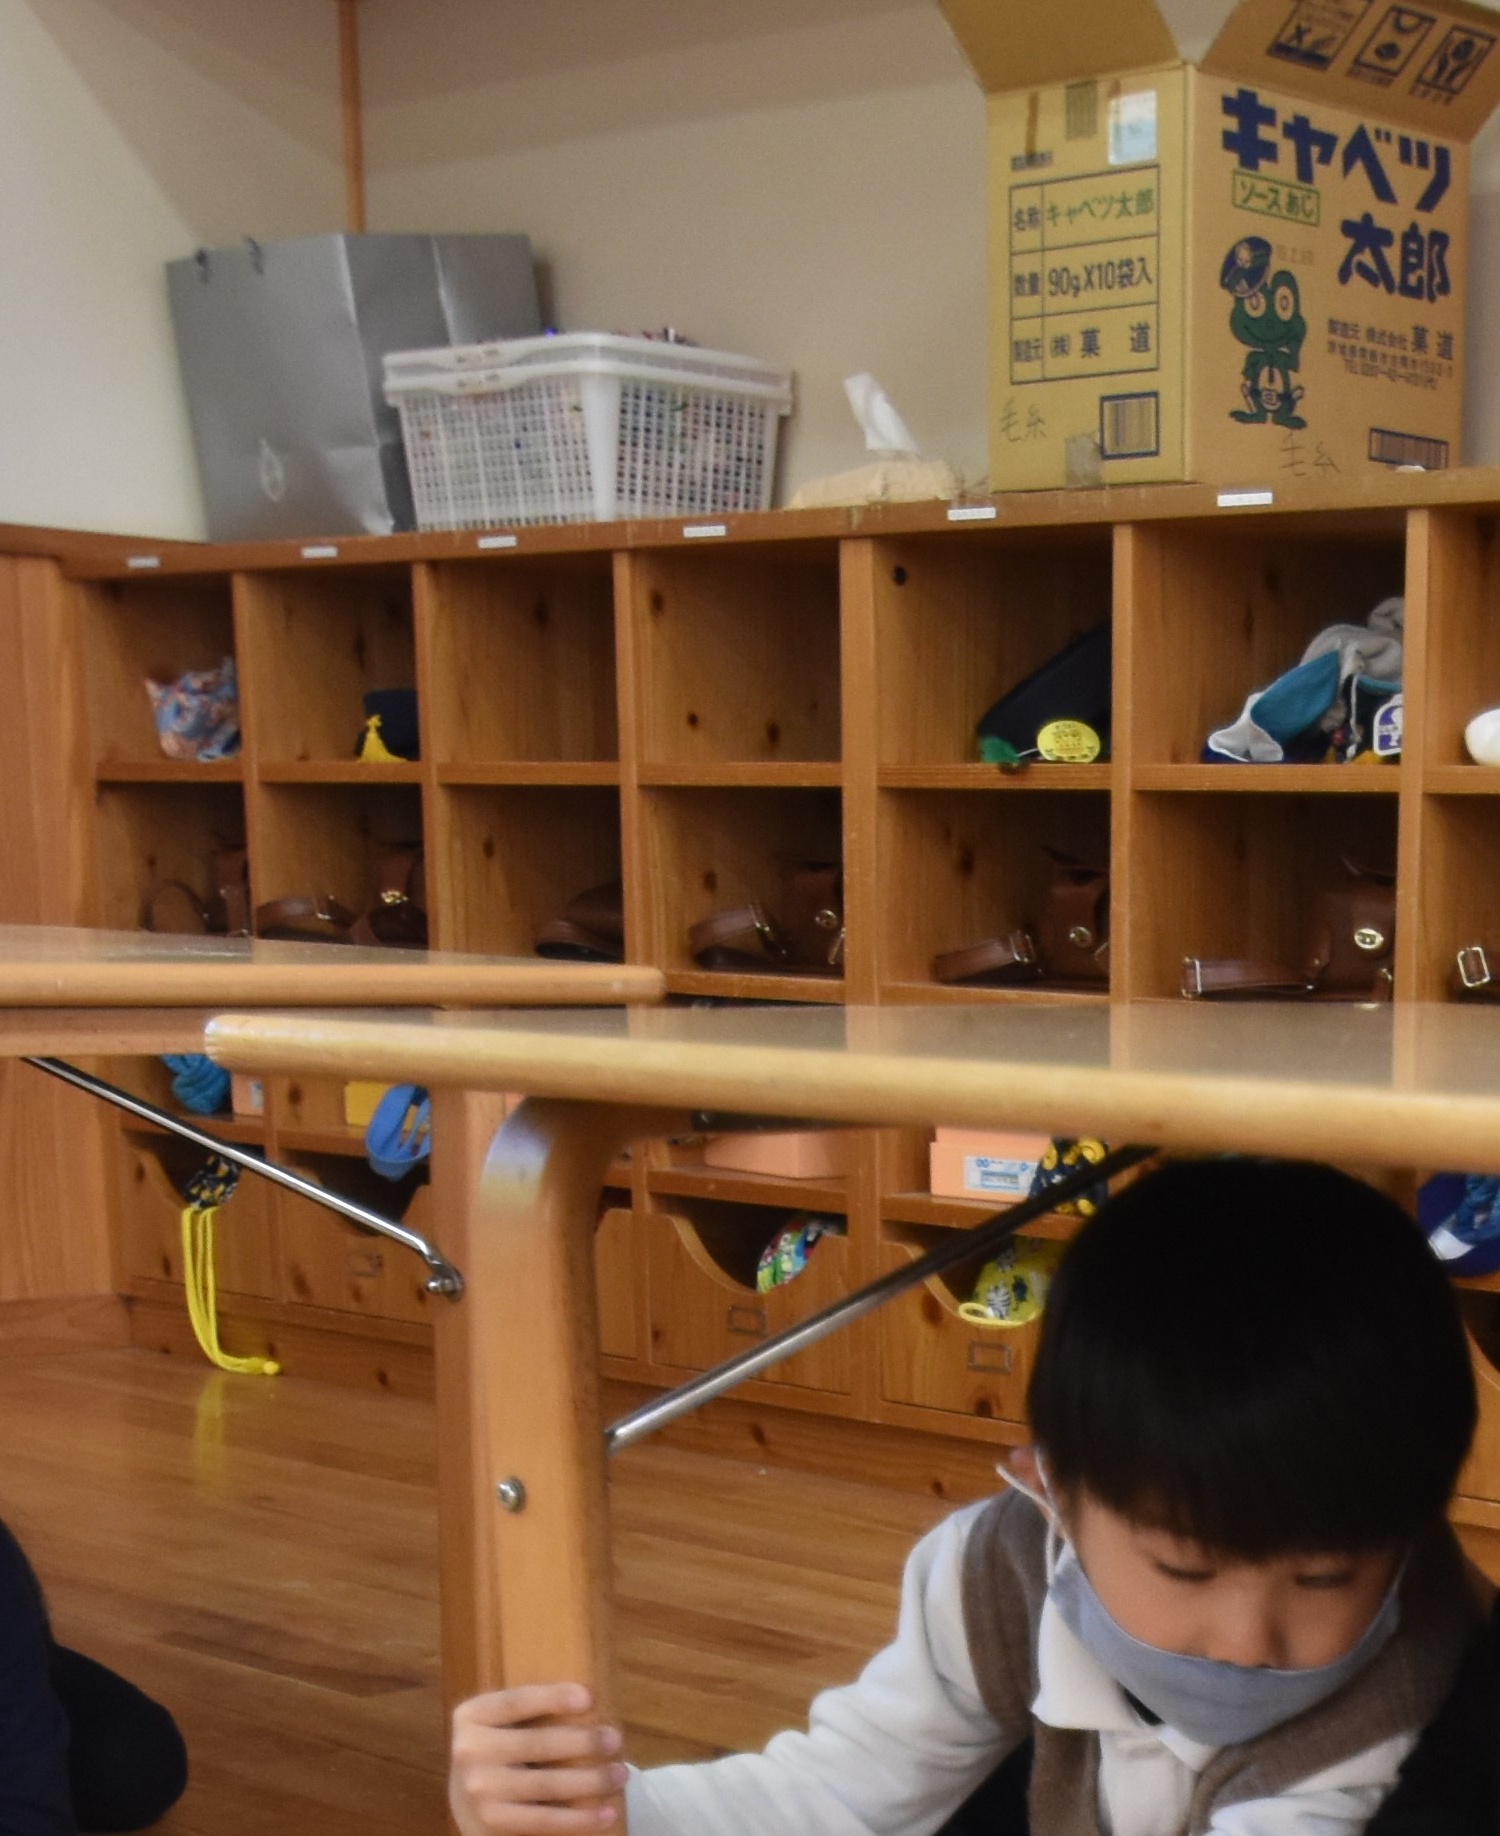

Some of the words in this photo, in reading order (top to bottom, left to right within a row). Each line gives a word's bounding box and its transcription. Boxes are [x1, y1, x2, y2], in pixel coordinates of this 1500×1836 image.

[1221, 87, 1451, 213] キャベツ
[1047, 187, 1155, 227] キャベツ太郎
[1337, 212, 1451, 304] 太郎
